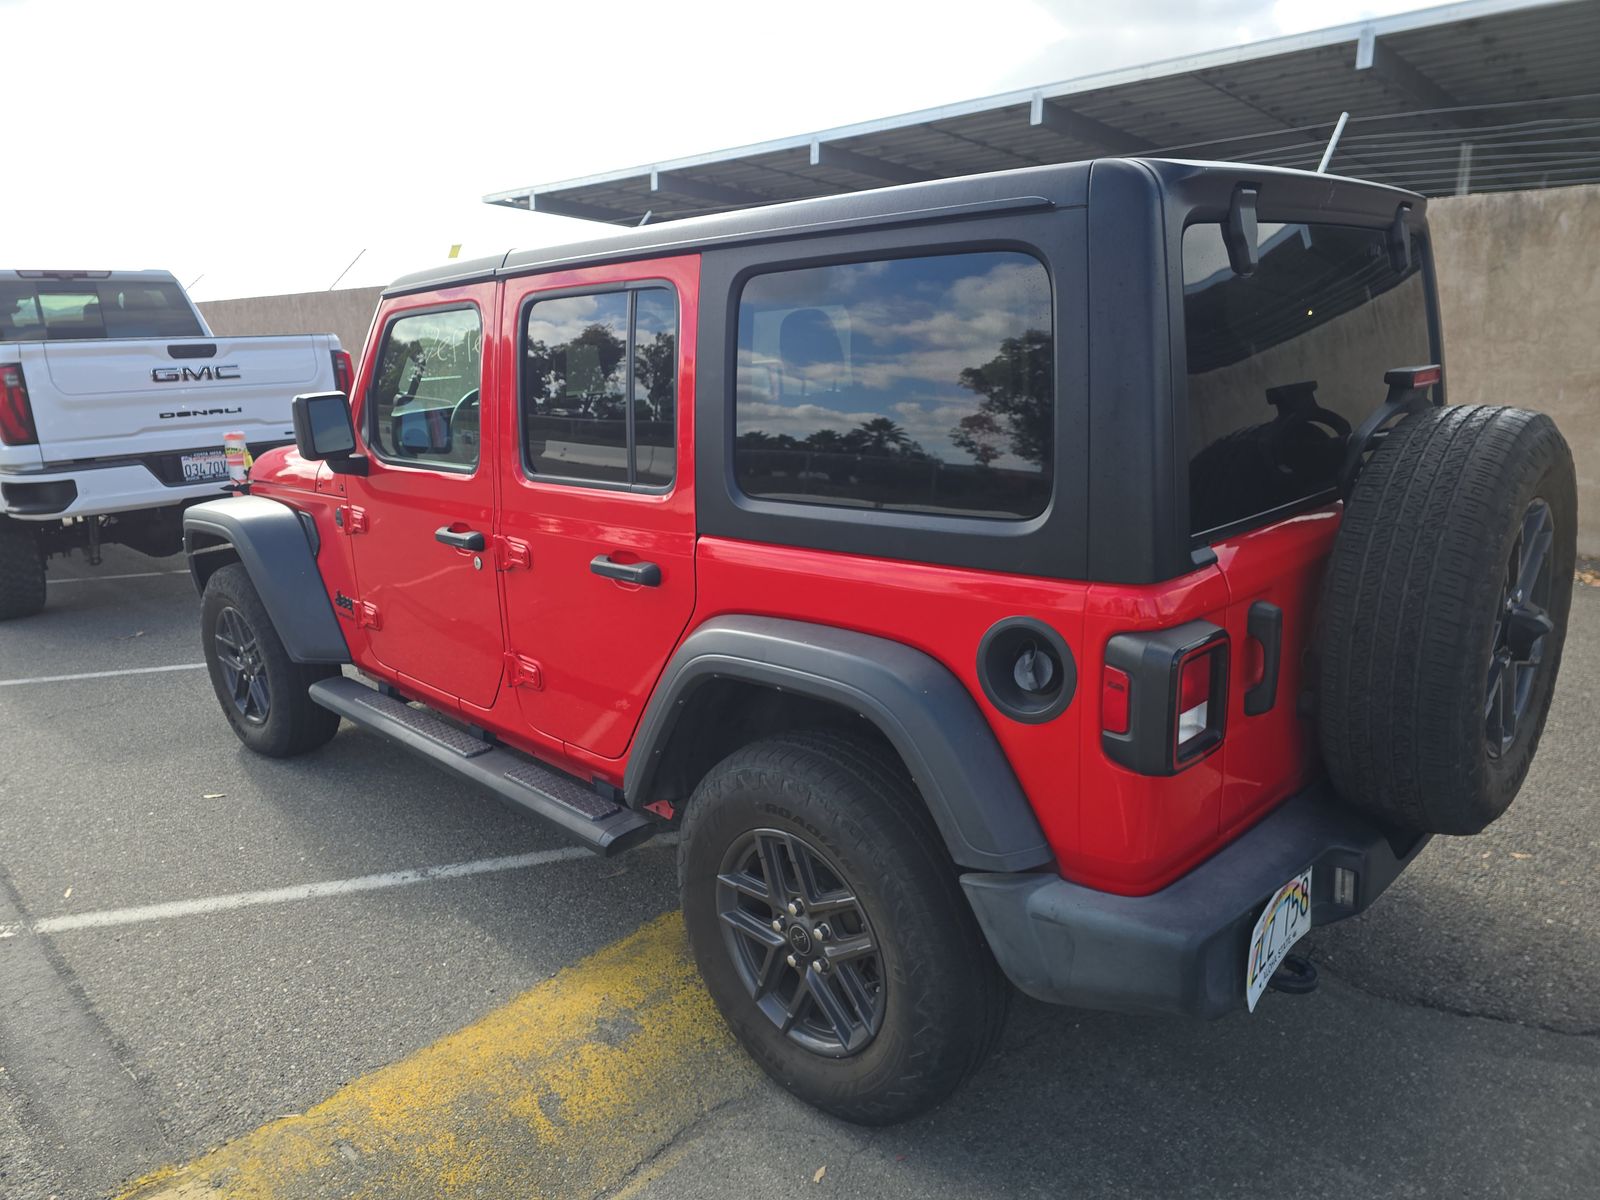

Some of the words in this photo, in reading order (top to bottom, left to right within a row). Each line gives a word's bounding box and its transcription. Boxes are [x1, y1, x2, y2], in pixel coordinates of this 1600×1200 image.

[151, 364, 241, 383] GMC
[159, 407, 242, 420] DENALI
[184, 460, 229, 478] 03470V
[1284, 877, 1309, 937] 758
